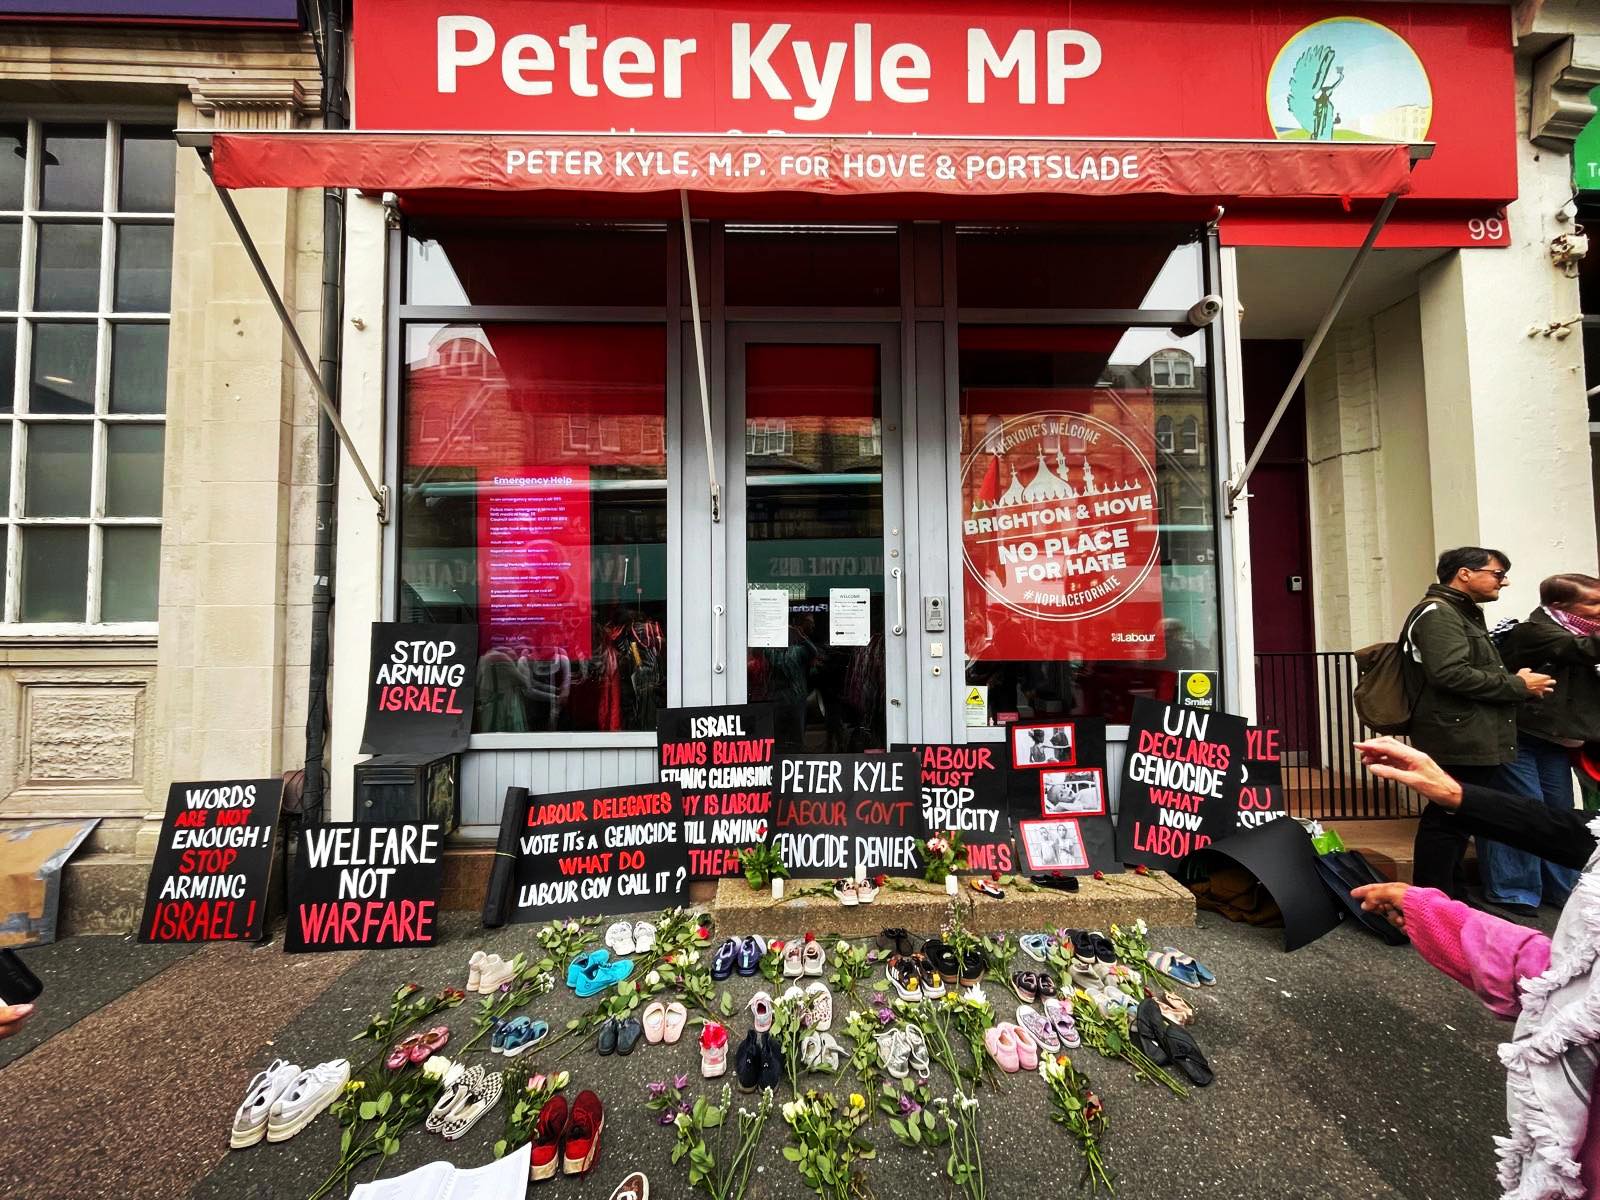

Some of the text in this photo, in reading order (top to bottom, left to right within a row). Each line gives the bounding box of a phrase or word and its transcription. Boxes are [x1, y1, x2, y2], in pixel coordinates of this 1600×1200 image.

[437, 15, 1102, 121] Peter Kyle MP
[506, 151, 1140, 181] PETER KYLE, M.P. FOR HOVE & PORTSLADE
[1468, 217, 1503, 241] 99
[1049, 422, 1101, 445] WELCOME
[494, 476, 573, 487] Emergency Help
[964, 494, 1153, 536] BRIGHTON & HOVE
[998, 528, 1130, 565] NO PLACE
[1015, 552, 1127, 584] FOR HATE
[1023, 575, 1121, 607] #NOPLACEFORHATE
[1120, 632, 1156, 642] Labour
[391, 640, 456, 664] STOP
[376, 663, 466, 688] ARMING
[378, 686, 464, 714] ISRAEL
[1184, 697, 1213, 706] Smile!
[690, 714, 746, 739] ISRAEL
[1163, 705, 1210, 741] UN
[662, 739, 775, 766] PLANS BLATANT
[912, 746, 996, 770] ABOUR
[1138, 729, 1231, 770] DECLARES
[1245, 729, 1281, 761] YLE
[781, 759, 904, 794] PETER KYLE
[921, 769, 974, 787] MUST
[1129, 752, 1227, 799] GENOCIDE
[185, 785, 257, 810] WORDS
[527, 791, 673, 827] LABOUR DELEGATES
[682, 795, 700, 816] HY
[704, 793, 720, 815] IS
[922, 787, 975, 809] STOP
[1149, 787, 1205, 813] WHAT
[1238, 785, 1272, 810] OU
[173, 808, 252, 827] ARE NOT
[775, 800, 914, 828] LABOUR GOVT
[922, 806, 1000, 833] MPLICITY
[1158, 807, 1203, 831] NOW
[520, 833, 560, 855] VOTE
[587, 835, 599, 850] A
[604, 821, 677, 848] GENOCIDE
[684, 818, 768, 845] TILL ARMING
[305, 824, 440, 868] WELFARE
[855, 835, 918, 870] DENIER
[966, 843, 1012, 872] IMES
[178, 849, 237, 874] STOP
[558, 849, 646, 876] WHAT DO
[159, 873, 247, 900] ARMING
[338, 867, 396, 900] NOT
[518, 878, 579, 908] LABOUR
[580, 876, 612, 900] GOV
[617, 873, 651, 896] CALL
[655, 871, 671, 894] IT
[299, 900, 435, 944] WARFARE
